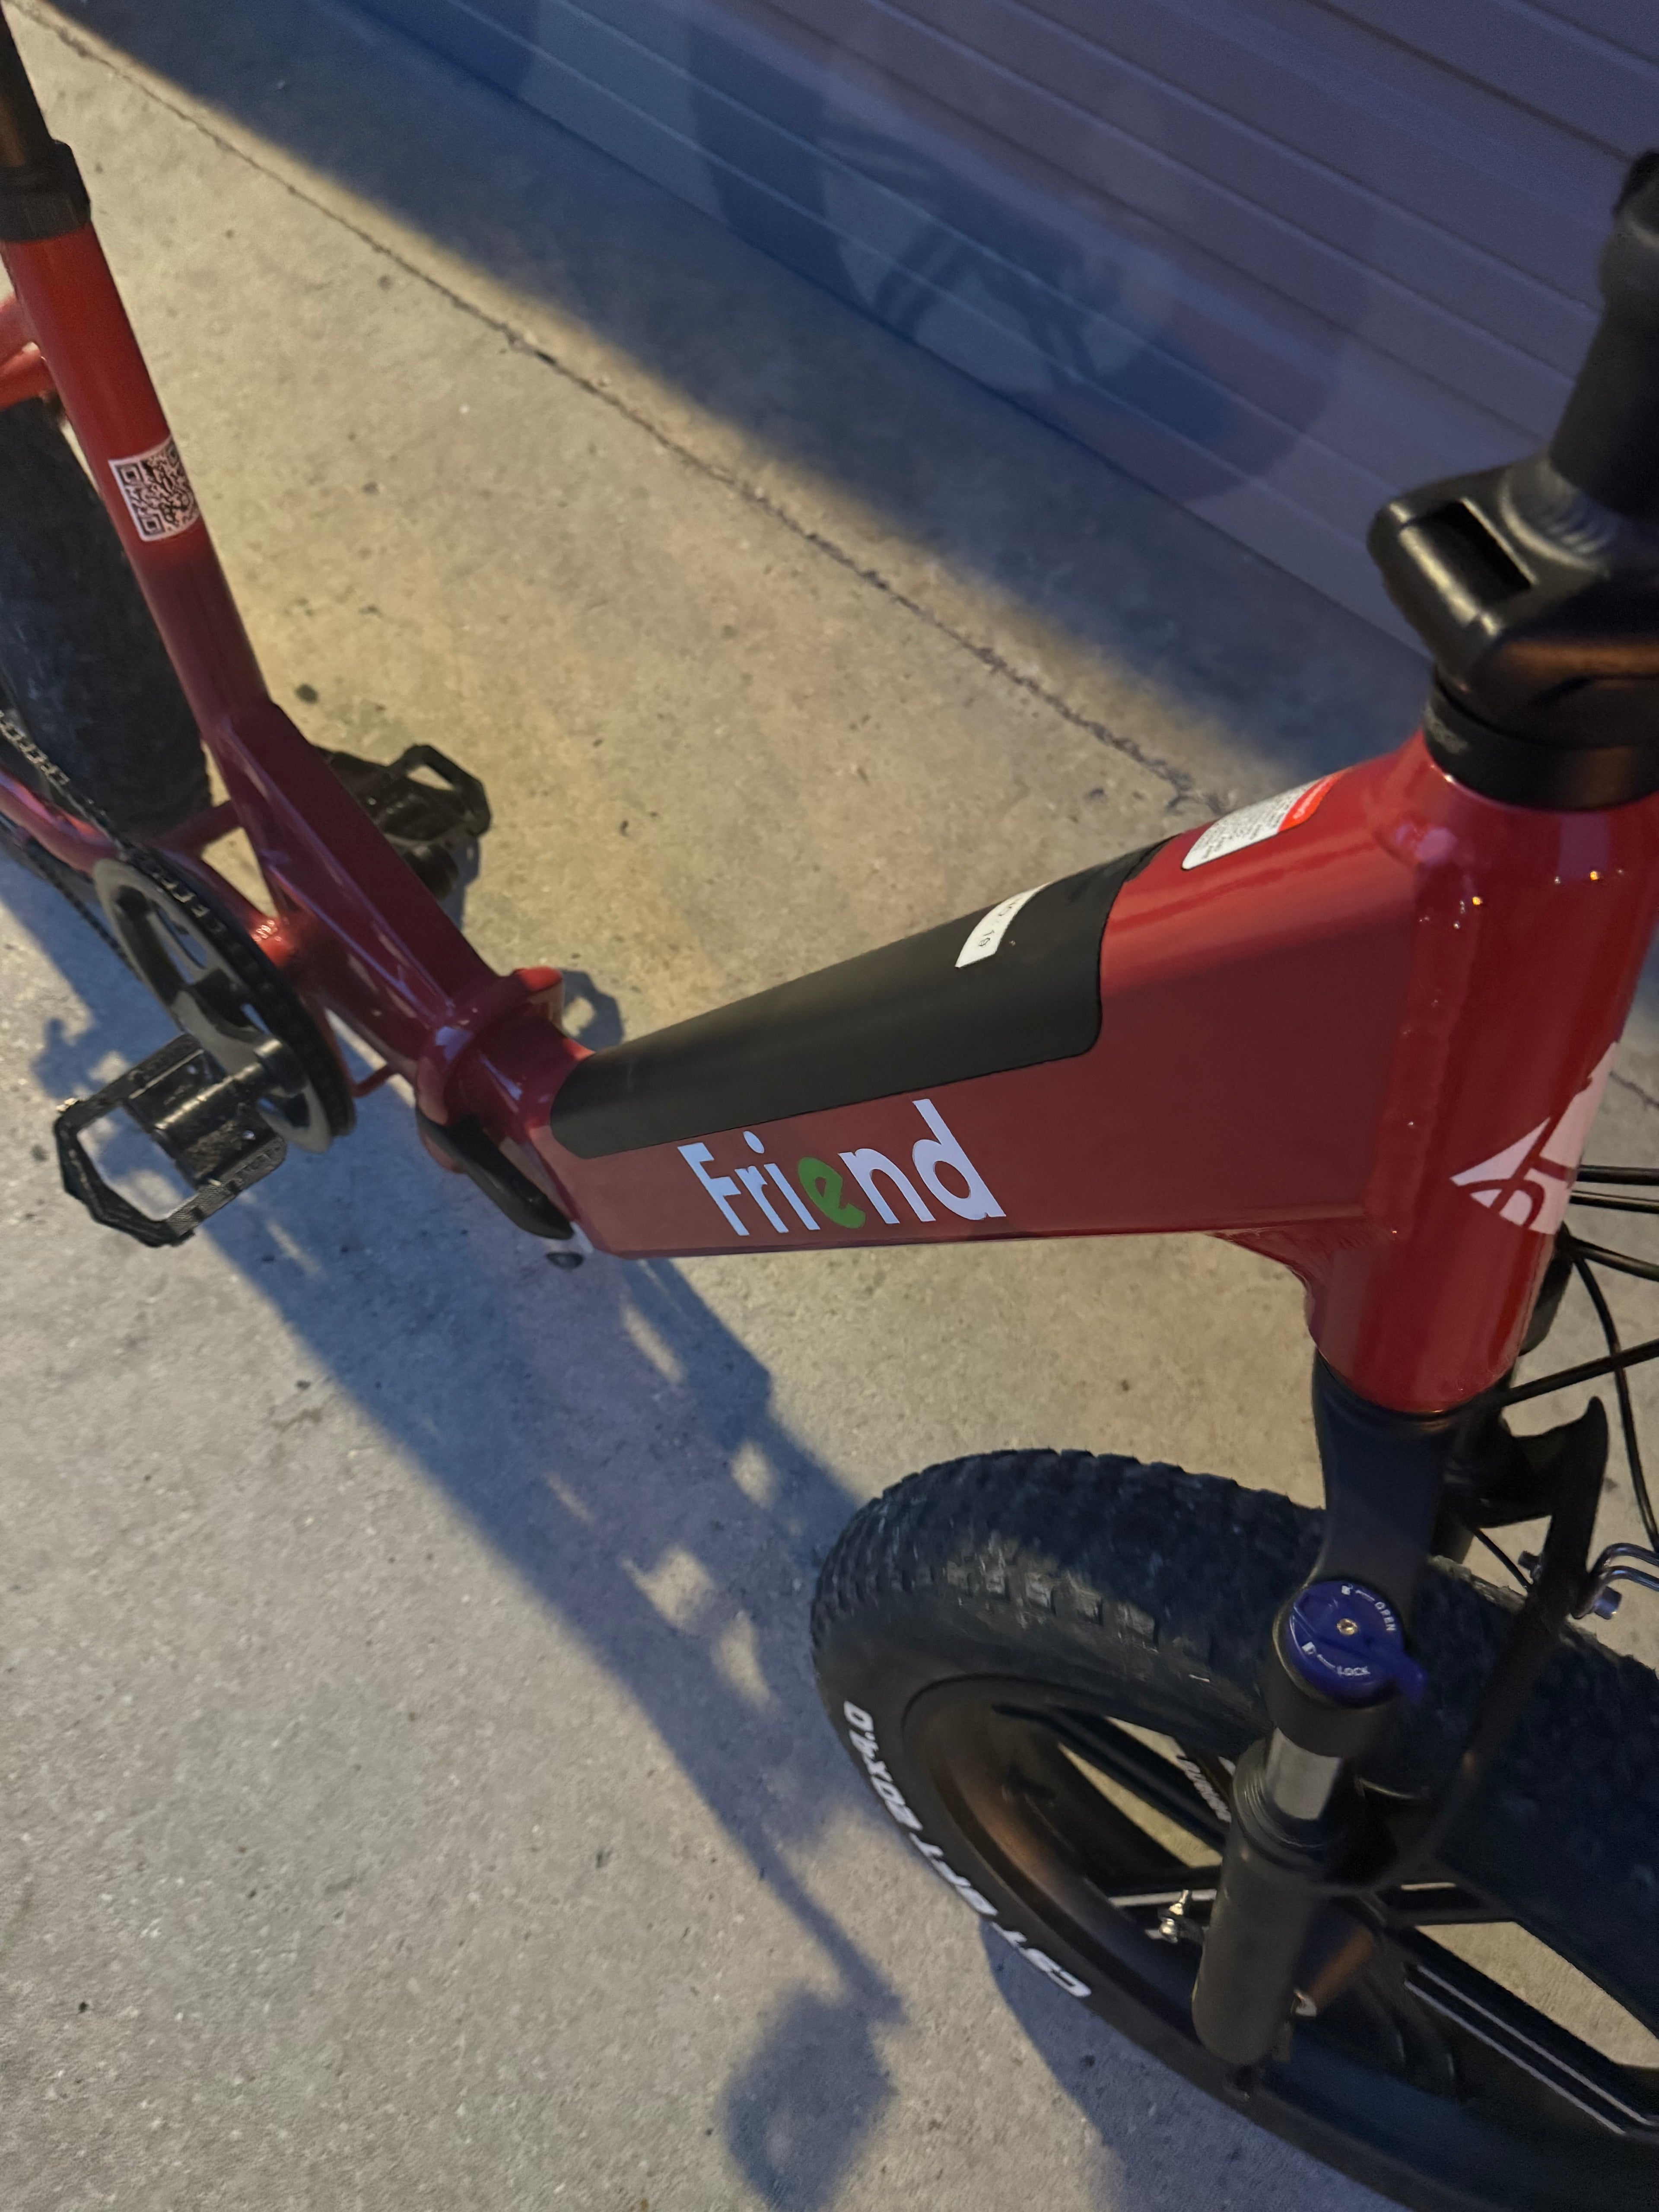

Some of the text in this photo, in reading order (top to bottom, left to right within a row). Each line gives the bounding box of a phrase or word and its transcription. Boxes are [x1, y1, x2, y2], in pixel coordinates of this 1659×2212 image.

[677, 1098, 1007, 1236] Friend
[1374, 1601, 1397, 1632] OPEN
[1336, 1665, 1371, 1677] LOCK
[992, 1921, 1092, 1998] CST
